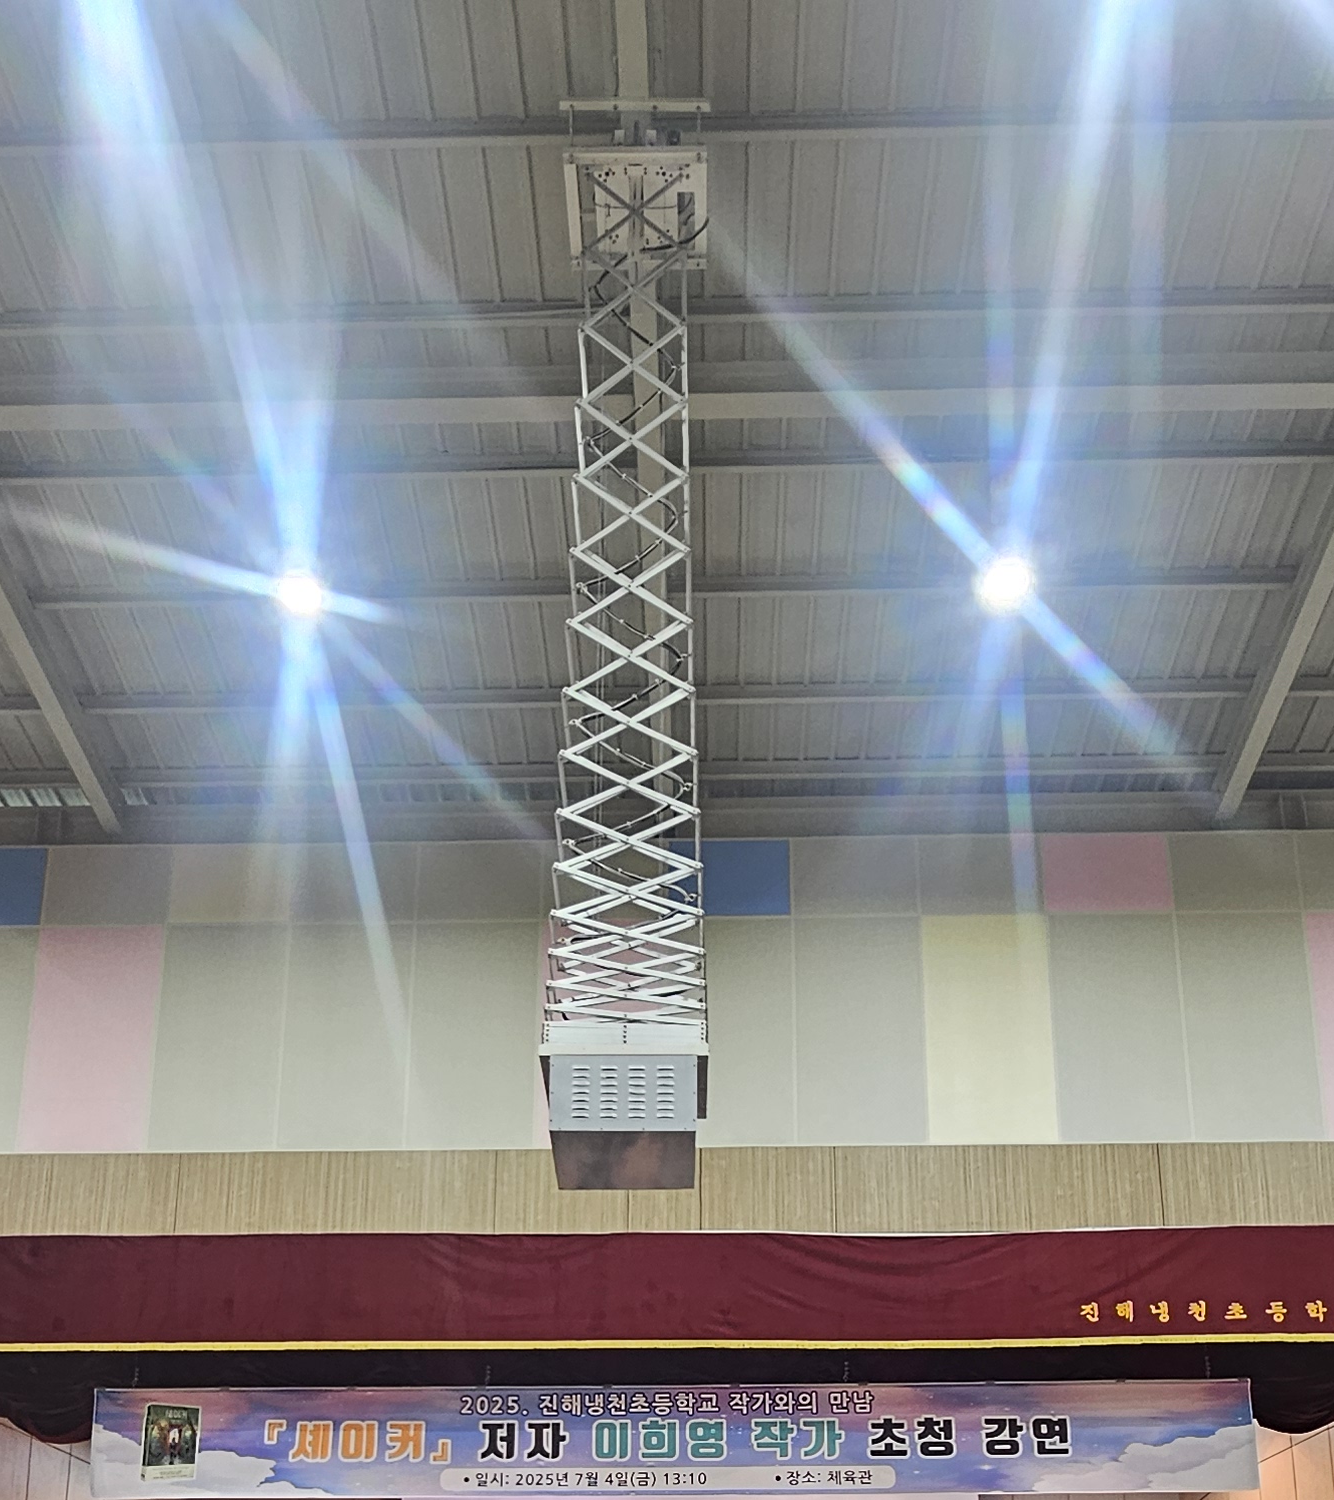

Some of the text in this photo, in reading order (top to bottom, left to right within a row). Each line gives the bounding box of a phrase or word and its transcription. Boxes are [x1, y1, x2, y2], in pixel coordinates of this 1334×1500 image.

[459, 1391, 875, 1417] 2025. 진해냉천초등학교 작가와의 만남
[478, 1418, 569, 1464] 저자
[591, 1416, 727, 1463] 이희영
[750, 1415, 845, 1461] 작가
[867, 1414, 957, 1460] 초청
[981, 1413, 1073, 1459] 강연
[475, 1469, 874, 1488] 일시: 2025년 7월 4일(금) 13:10 장소: 체육관
